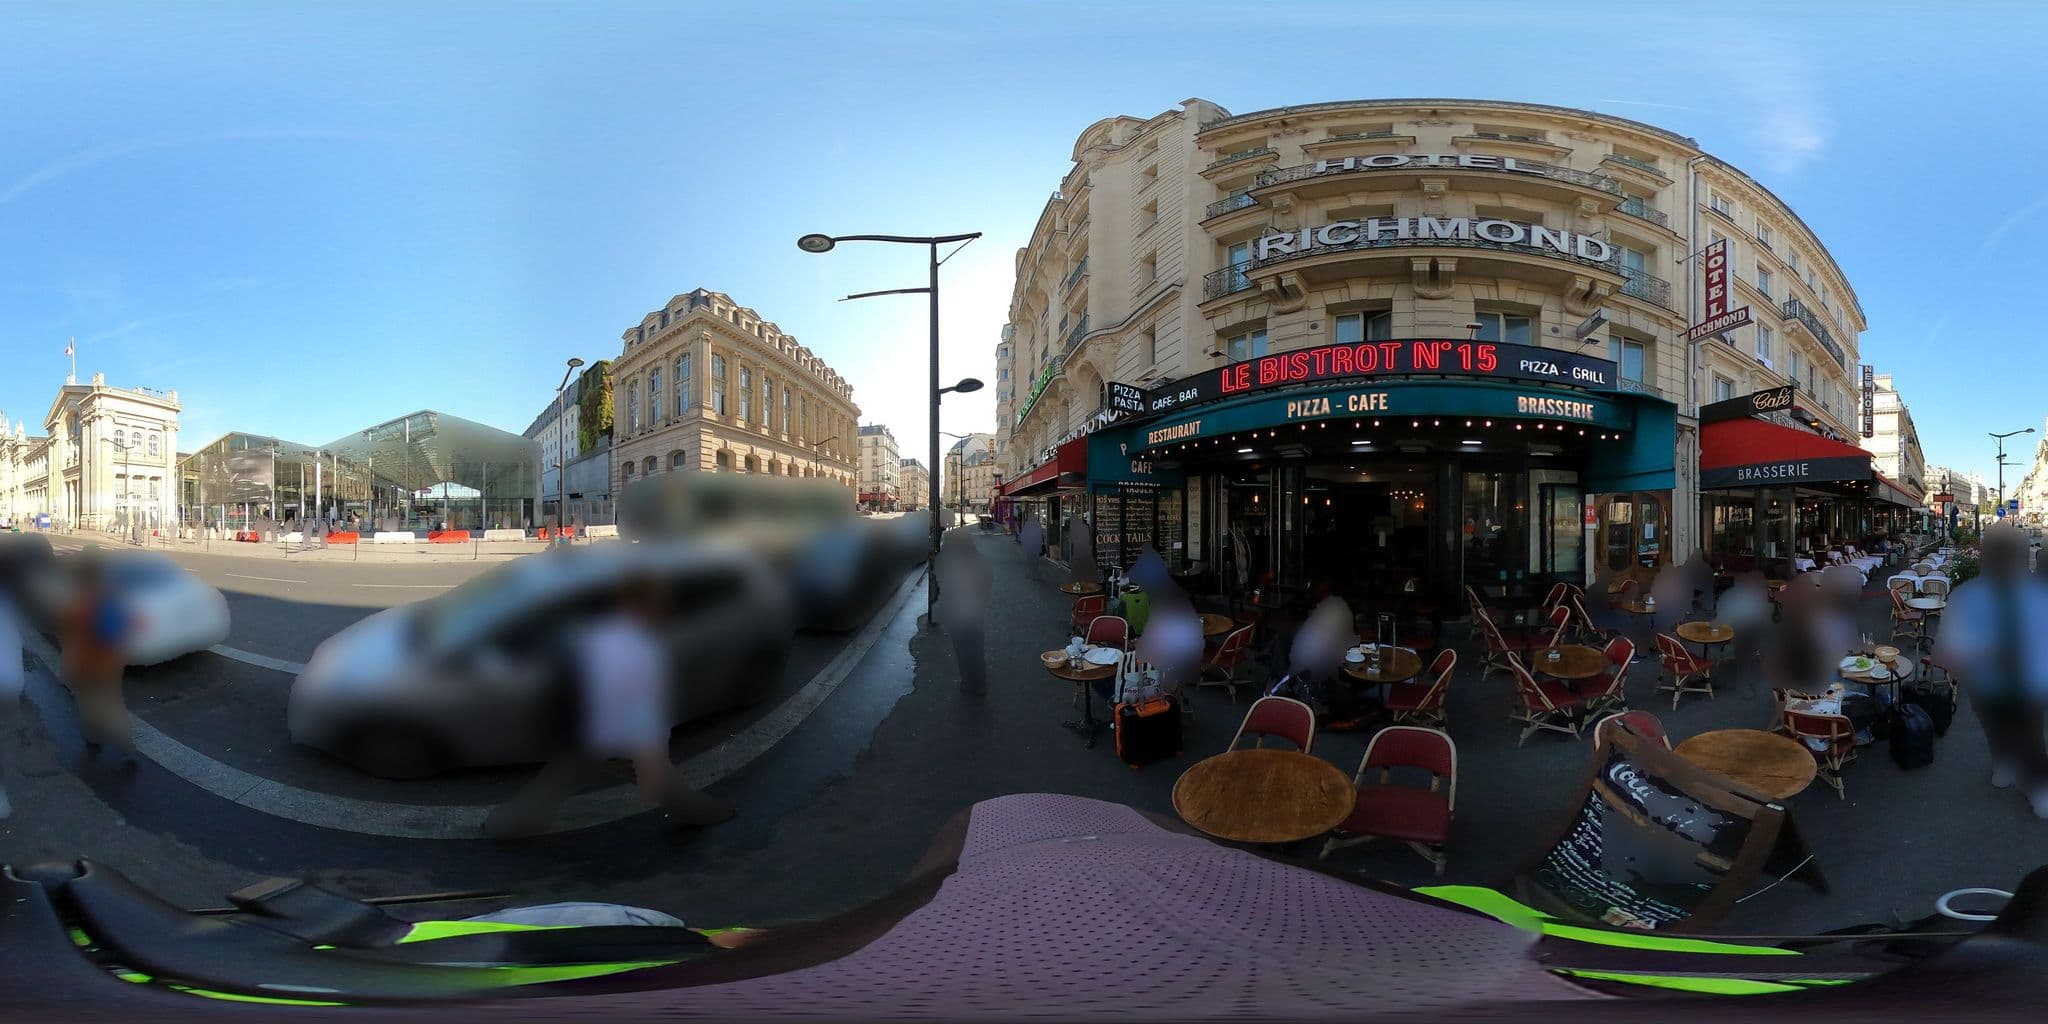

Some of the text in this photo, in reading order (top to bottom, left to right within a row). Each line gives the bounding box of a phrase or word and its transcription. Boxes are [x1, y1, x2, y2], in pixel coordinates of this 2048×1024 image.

[1315, 153, 1544, 175] HOTEL
[1259, 217, 1611, 262] RICHMOND
[1707, 239, 1726, 319] HOTEL
[1690, 309, 1747, 340] RICHMOND
[1221, 363, 1251, 393] LE
[1259, 342, 1402, 385] BISTROT
[1520, 359, 1559, 376] PIZZA
[1572, 366, 1606, 384] GRILL
[1864, 365, 1873, 389] NEW
[1113, 384, 1141, 400] PIZZA
[1179, 388, 1198, 402] BAR
[1752, 388, 1792, 410] Café
[1114, 396, 1145, 413] PASTA
[1287, 397, 1331, 418] PIZZA
[1348, 393, 1389, 412] CAFE
[1517, 396, 1594, 420] BRASSERIE
[1864, 391, 1873, 433] HOTEL
[1148, 420, 1202, 445] RESTAURANT
[1131, 460, 1153, 474] CAFE
[1738, 462, 1810, 481] BRASSERIE
